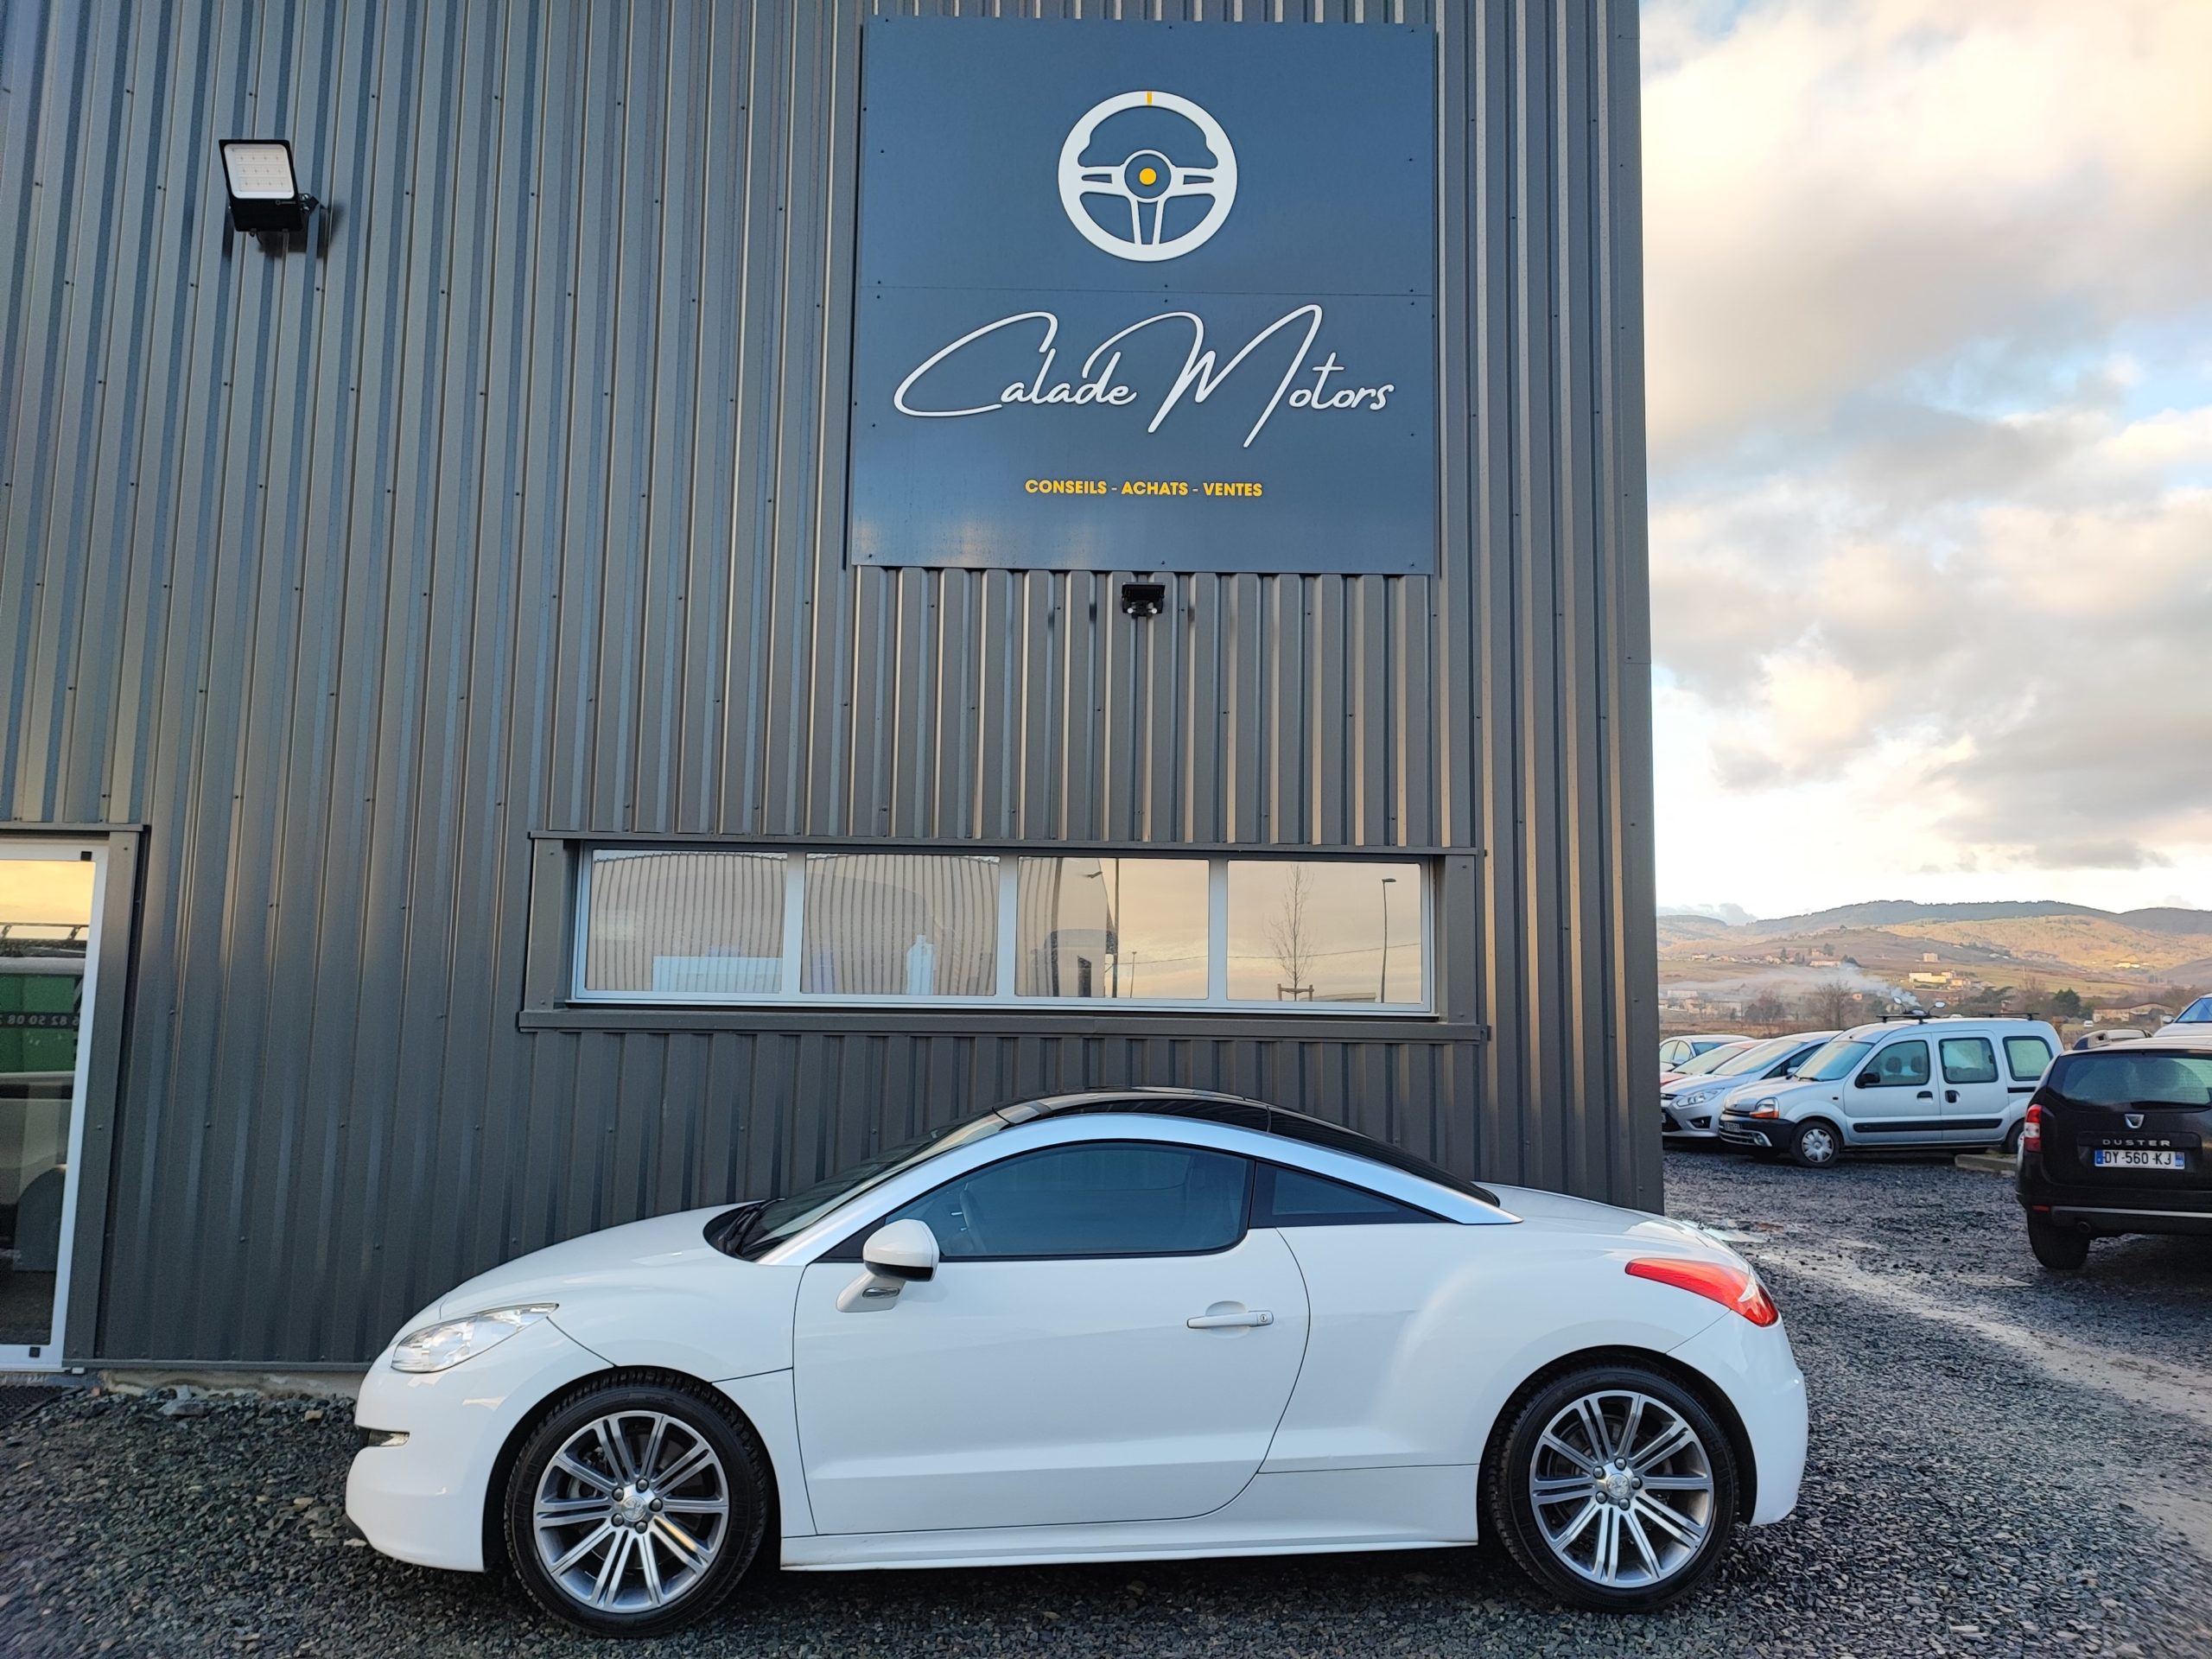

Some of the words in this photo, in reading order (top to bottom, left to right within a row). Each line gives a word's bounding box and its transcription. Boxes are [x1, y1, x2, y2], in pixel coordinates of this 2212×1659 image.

[894, 311, 1137, 416] Calade
[1083, 304, 1395, 448] Motors
[1025, 479, 1108, 495] CONSEILS
[1121, 480, 1189, 497] ACHATS
[1203, 482, 1263, 498] VENTES
